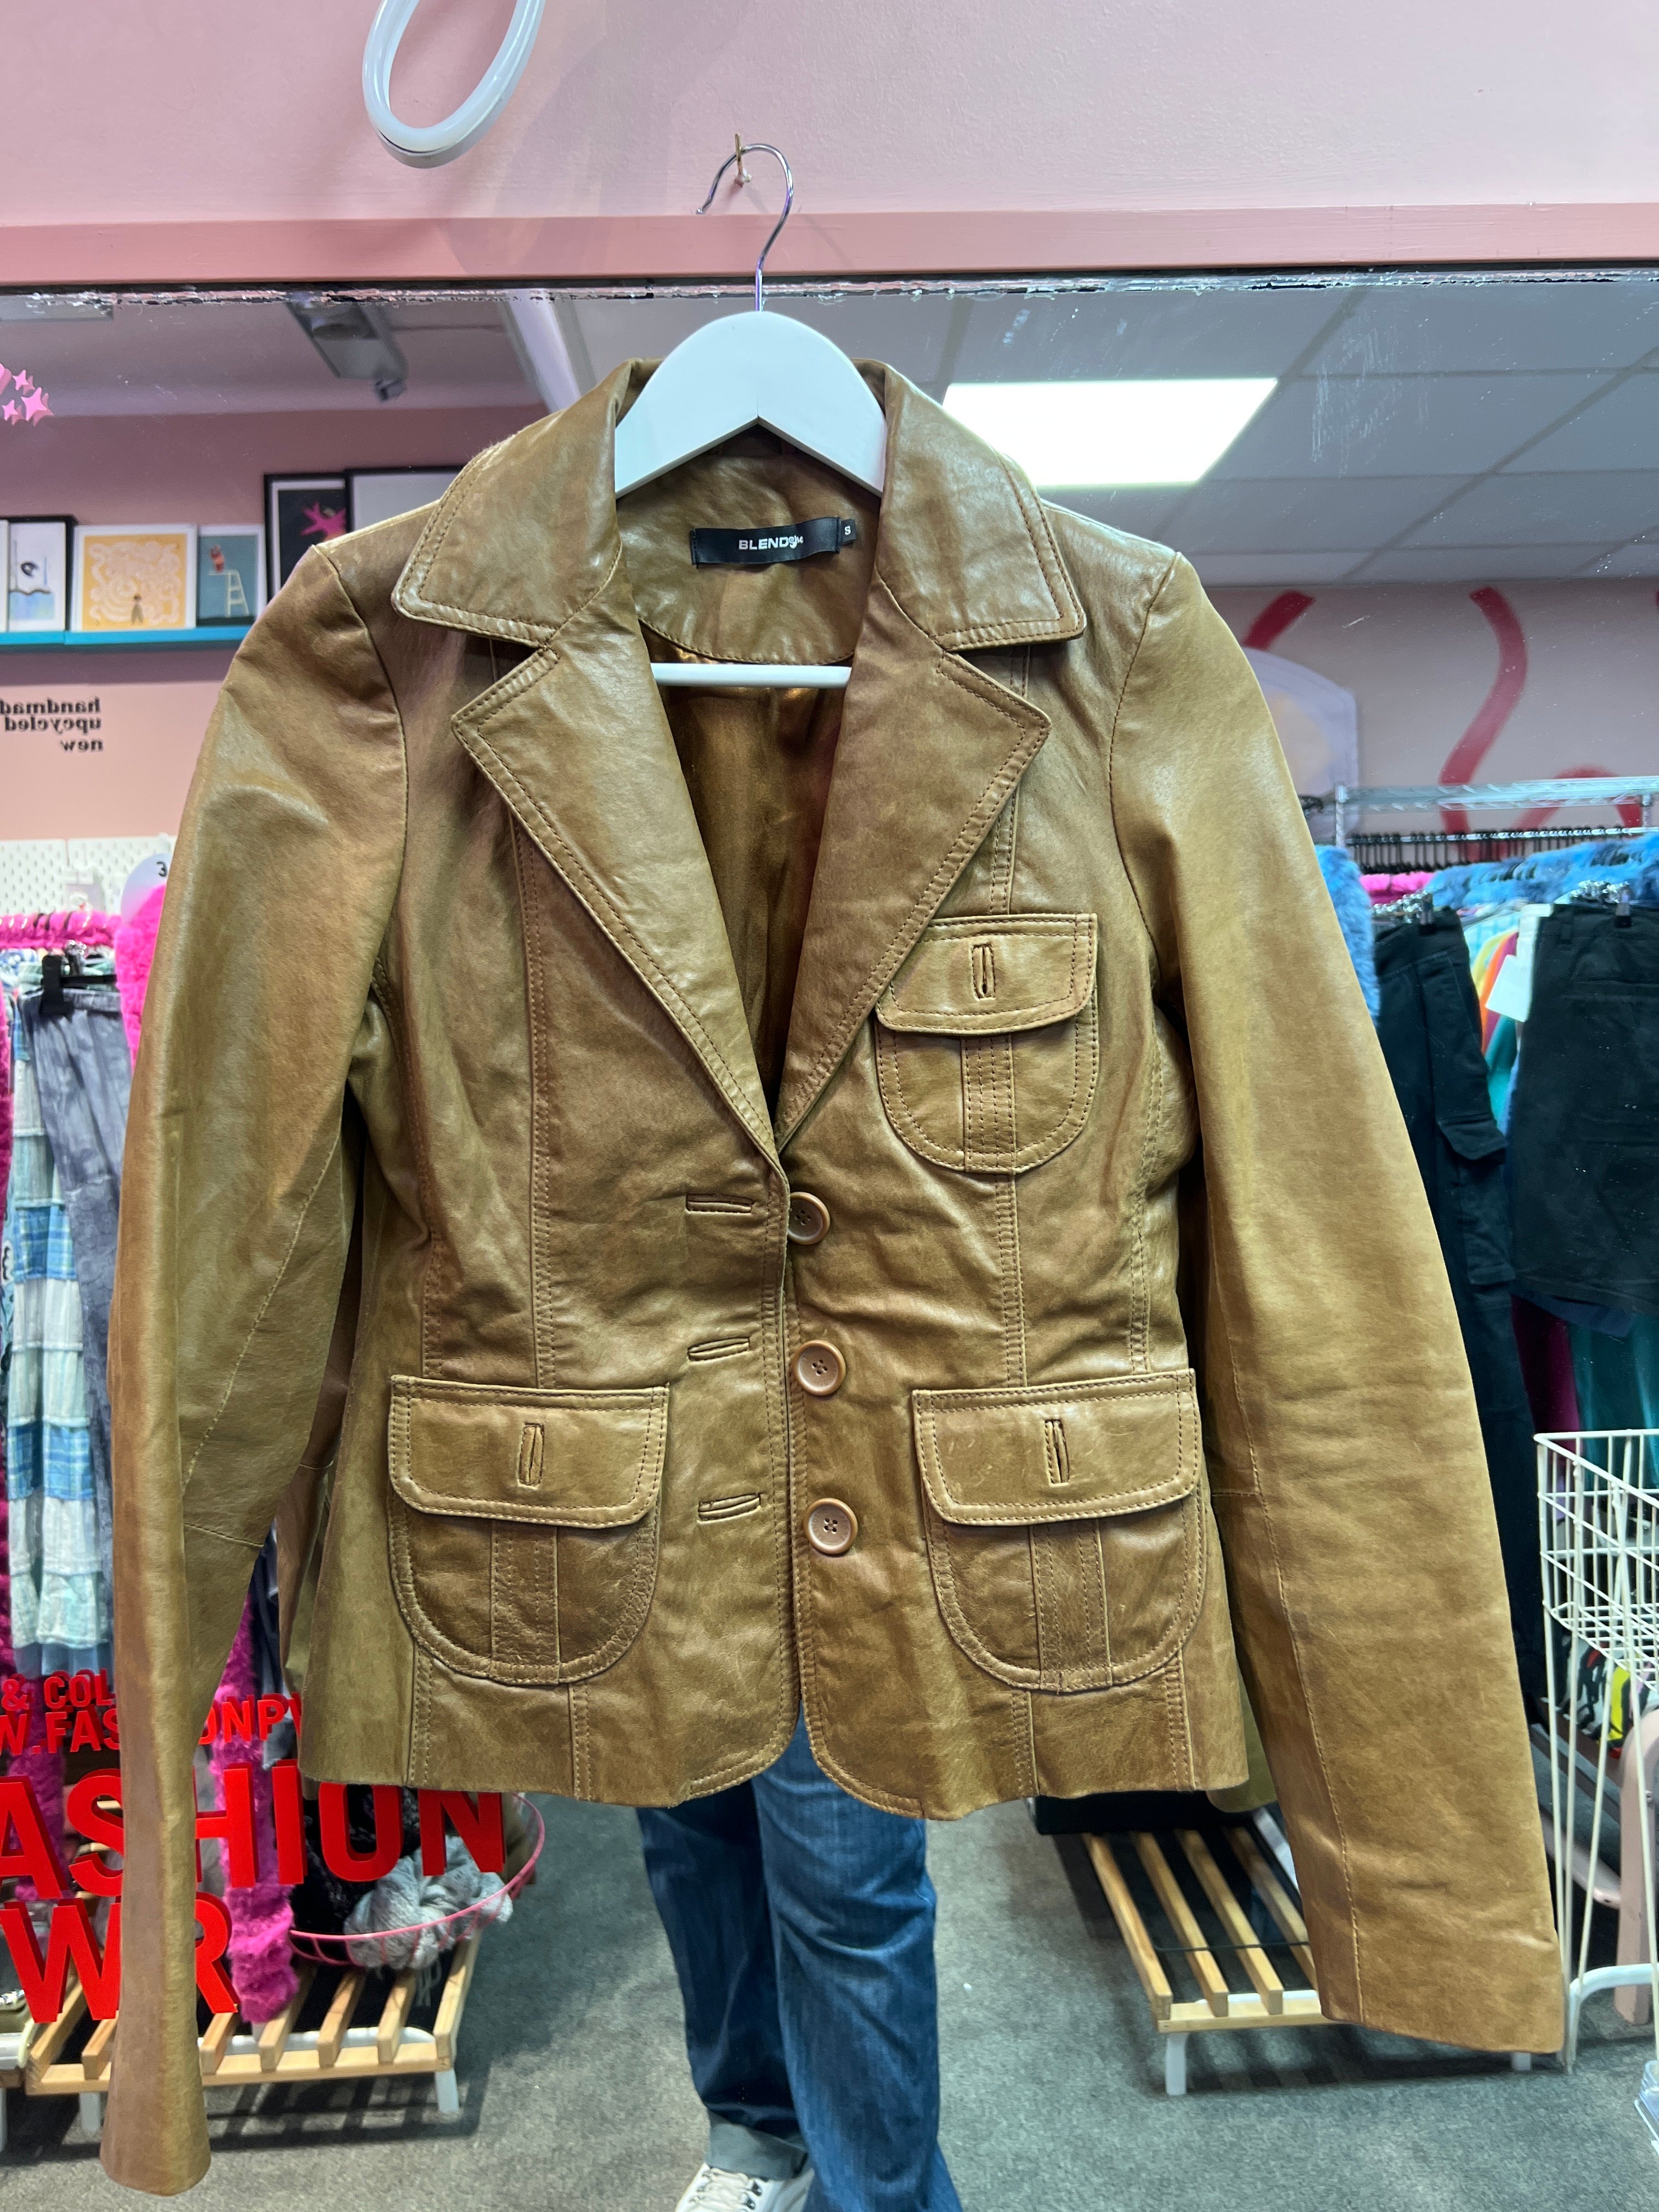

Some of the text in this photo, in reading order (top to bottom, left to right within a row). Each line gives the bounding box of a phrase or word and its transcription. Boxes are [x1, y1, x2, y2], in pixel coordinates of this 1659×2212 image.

[844, 526, 851, 535] S
[1, 1674, 114, 1711] & COL
